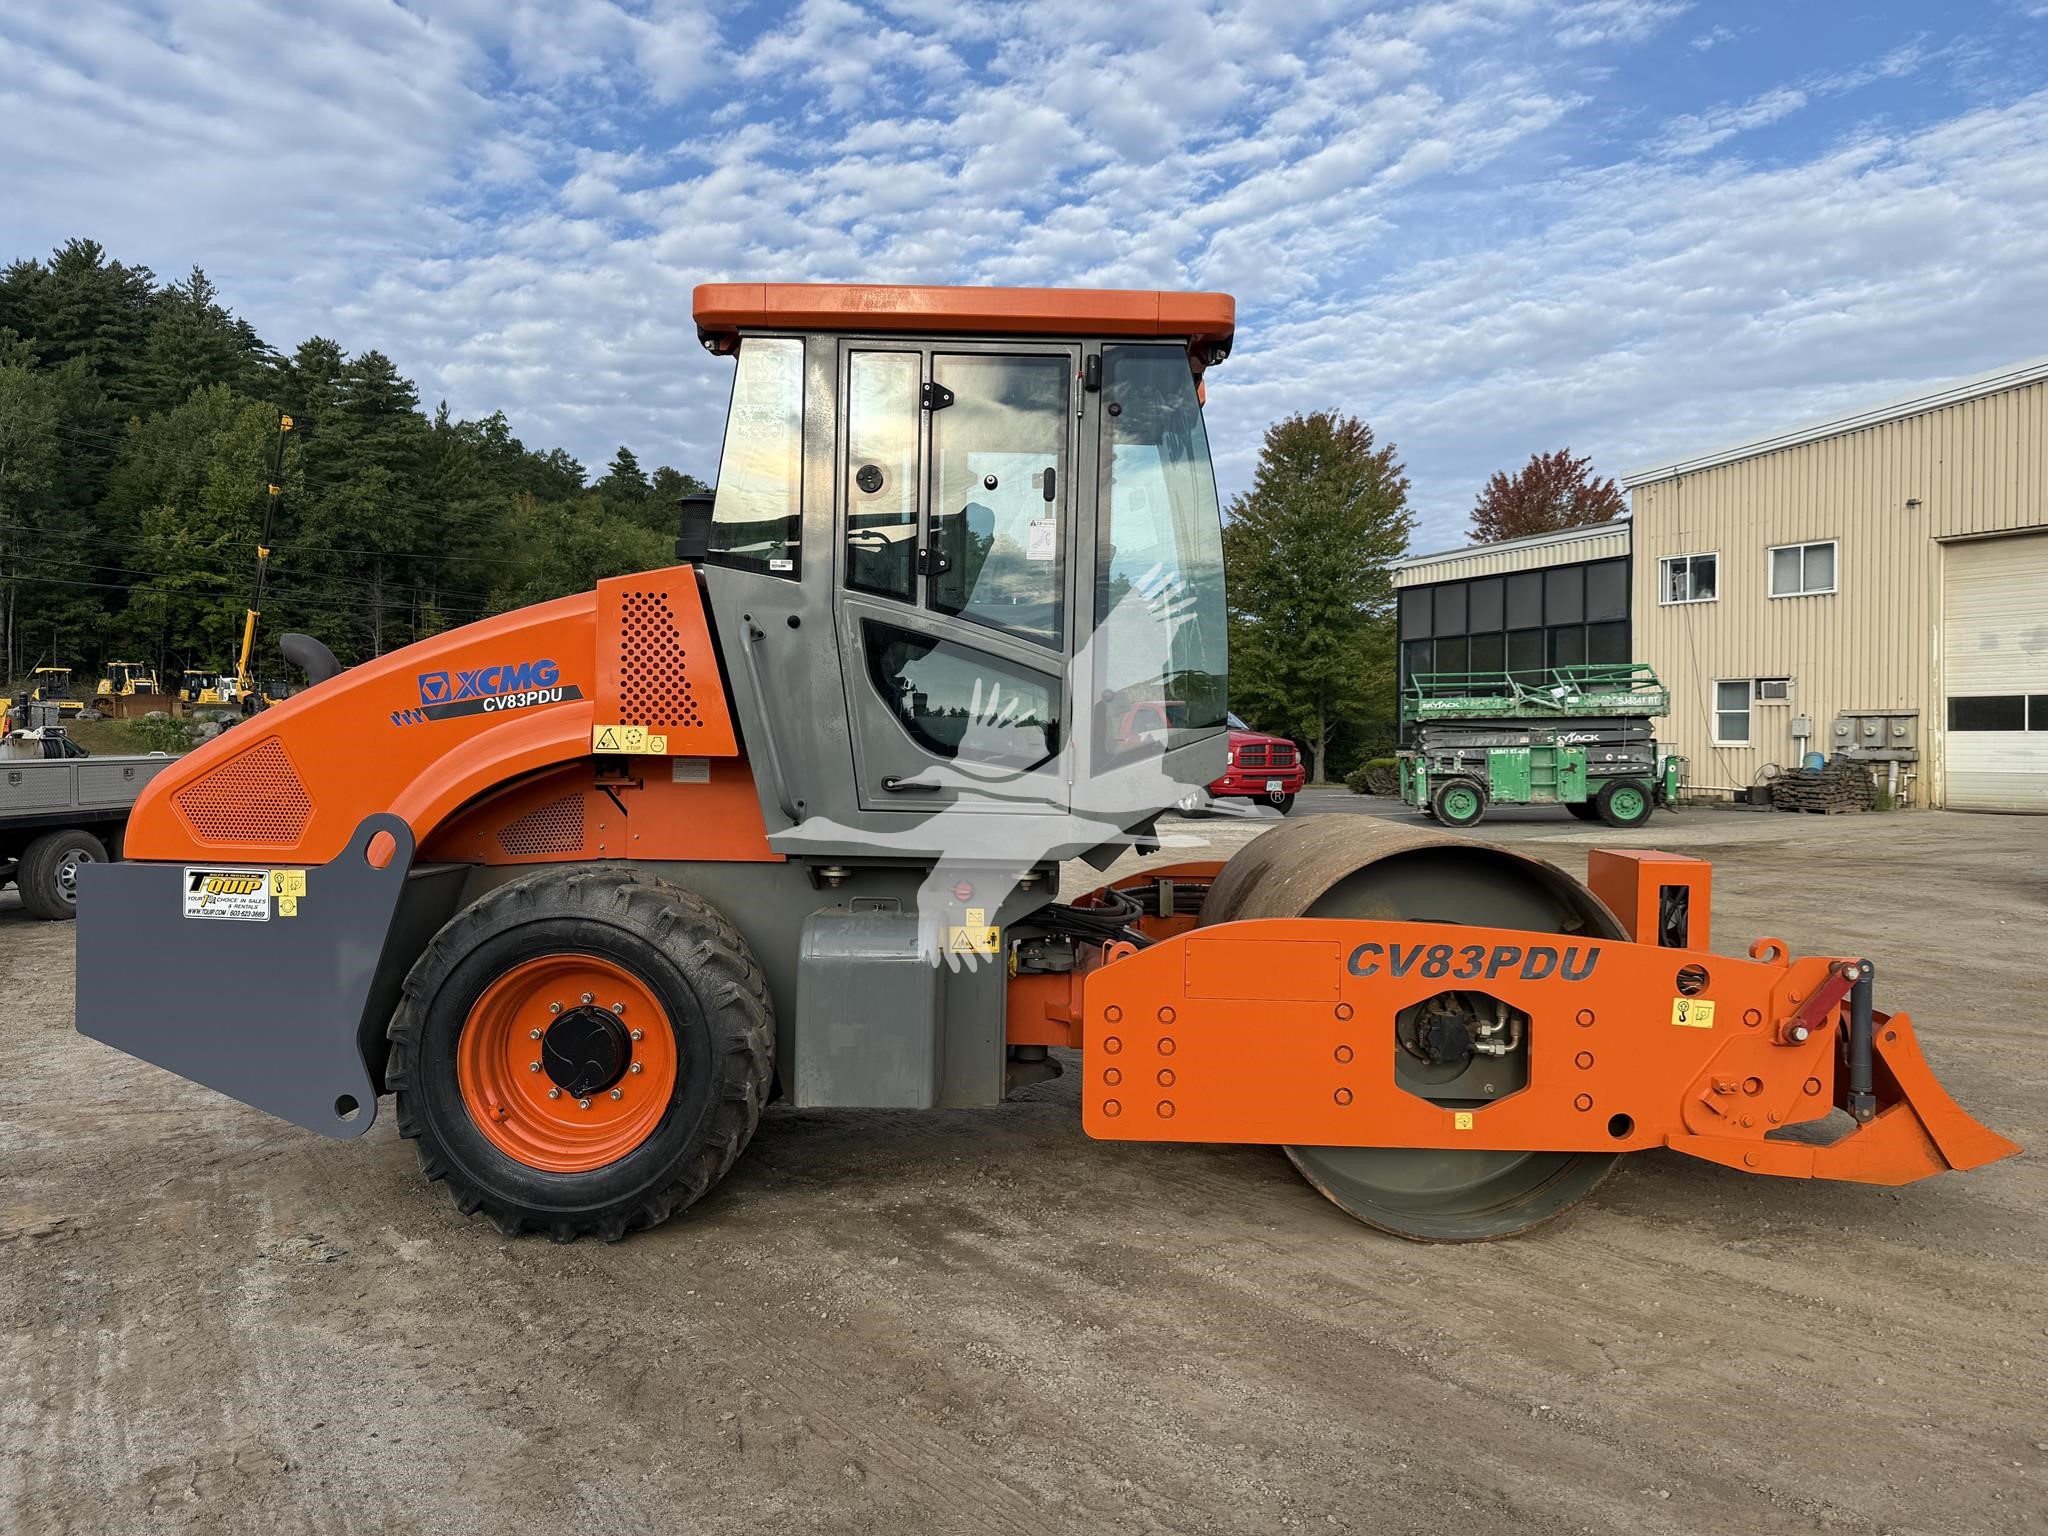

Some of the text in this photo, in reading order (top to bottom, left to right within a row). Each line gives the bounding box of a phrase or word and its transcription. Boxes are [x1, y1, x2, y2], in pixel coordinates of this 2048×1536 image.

[452, 658, 560, 700] XCMG
[483, 687, 562, 712] CV83PDU
[1422, 700, 1460, 708] SKYJACK
[1346, 942, 1601, 981] CV83PDU
